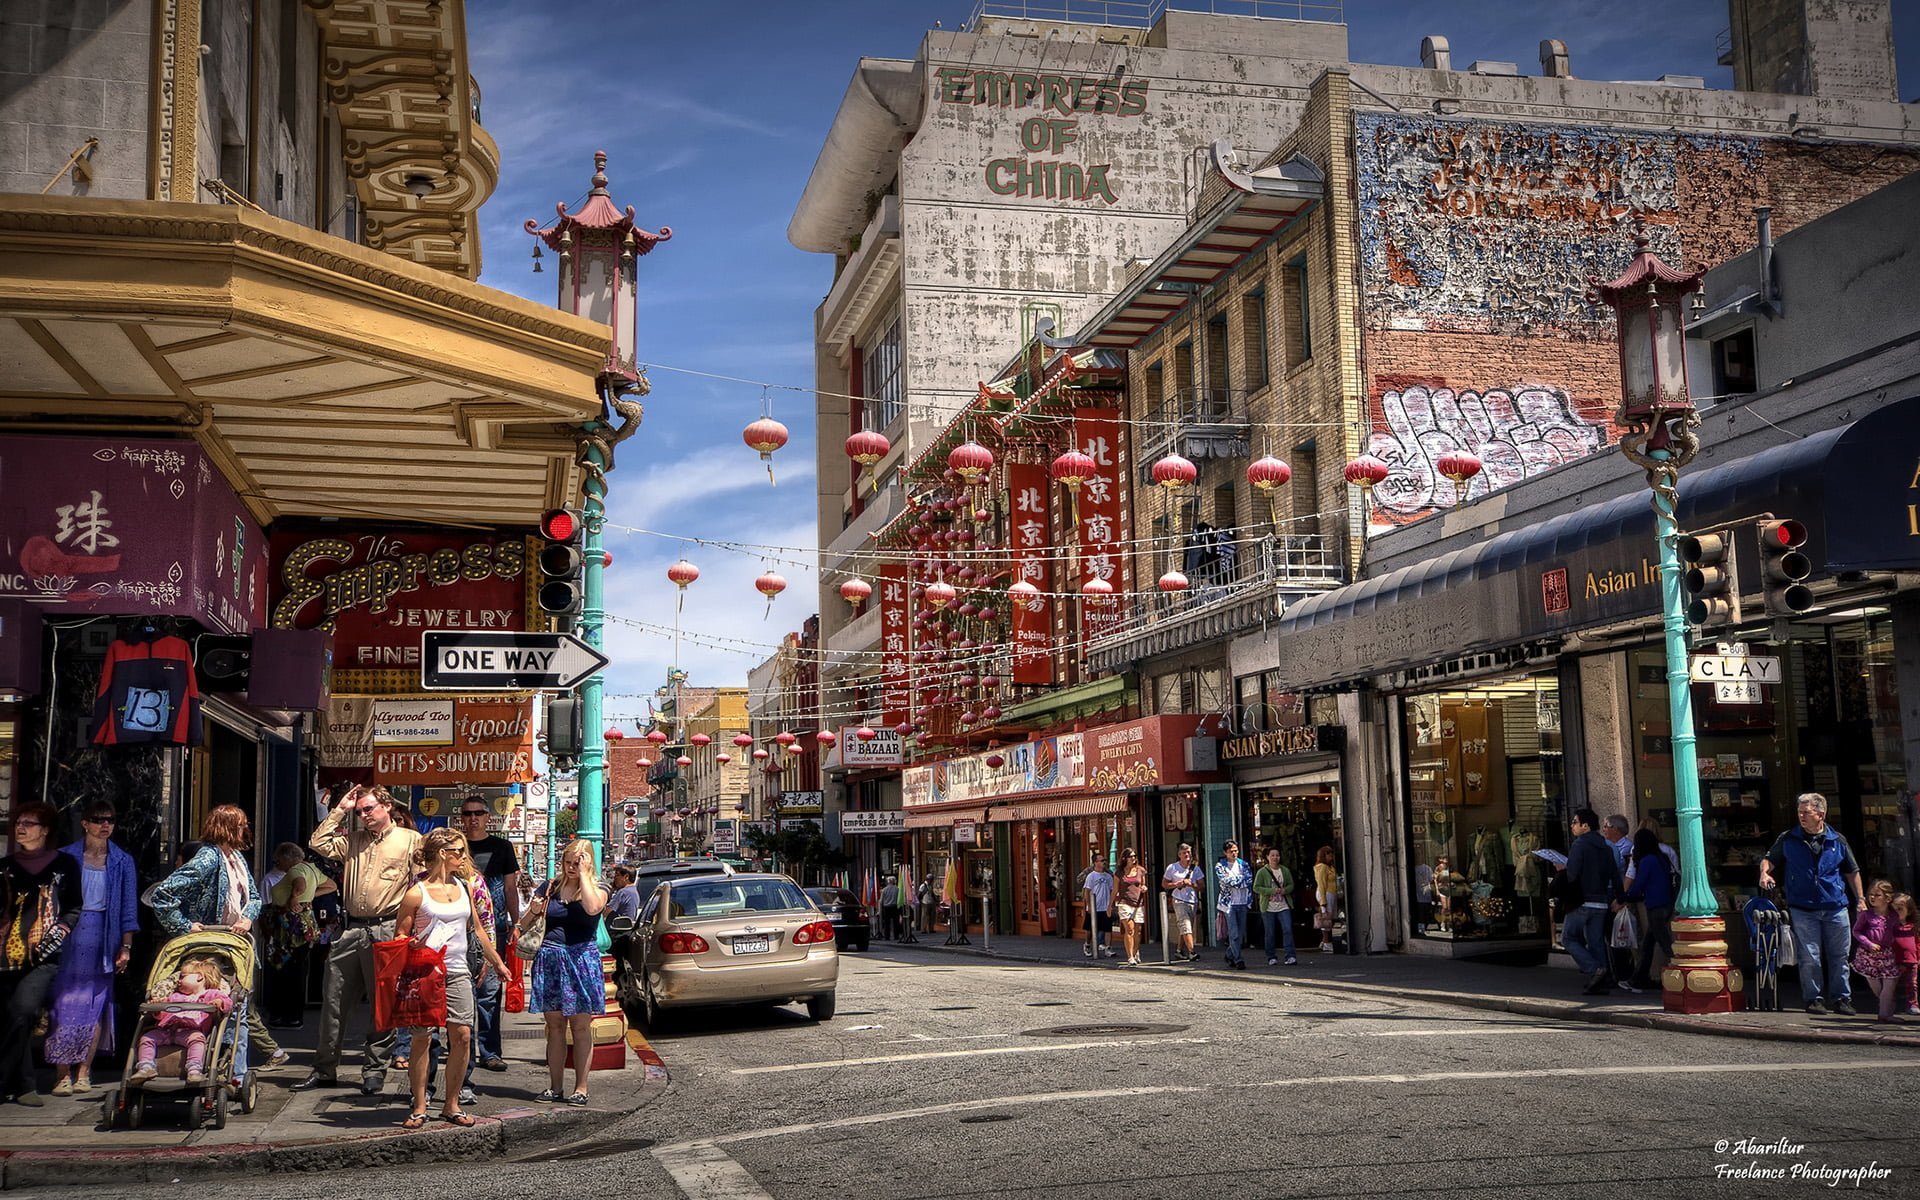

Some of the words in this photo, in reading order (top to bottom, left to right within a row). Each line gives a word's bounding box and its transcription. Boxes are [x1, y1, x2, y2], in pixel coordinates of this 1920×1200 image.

[934, 67, 1149, 117] EMPRESS
[1021, 117, 1078, 155] OF
[985, 157, 1119, 205] CHINA
[55, 491, 120, 554] 珠
[358, 535, 404, 561] The
[272, 539, 525, 633] Empress
[1585, 570, 1636, 599] Asian
[389, 609, 513, 627] JEWELRY
[1017, 630, 1046, 641] Peking
[358, 646, 419, 665] FINE
[444, 650, 495, 670] ONE
[504, 650, 555, 670] WAY
[1701, 661, 1770, 677] CLAY
[343, 703, 352, 711] &
[430, 711, 450, 721] Too
[329, 724, 364, 732] GIFTS
[872, 730, 899, 740] KING
[324, 745, 369, 753] CENTER
[858, 744, 900, 754] BAZAAR
[1222, 734, 1258, 759] ASIAN
[1260, 727, 1314, 755] STYLES
[378, 752, 428, 774] GIFTS
[438, 751, 528, 772] SOUVENIRS
